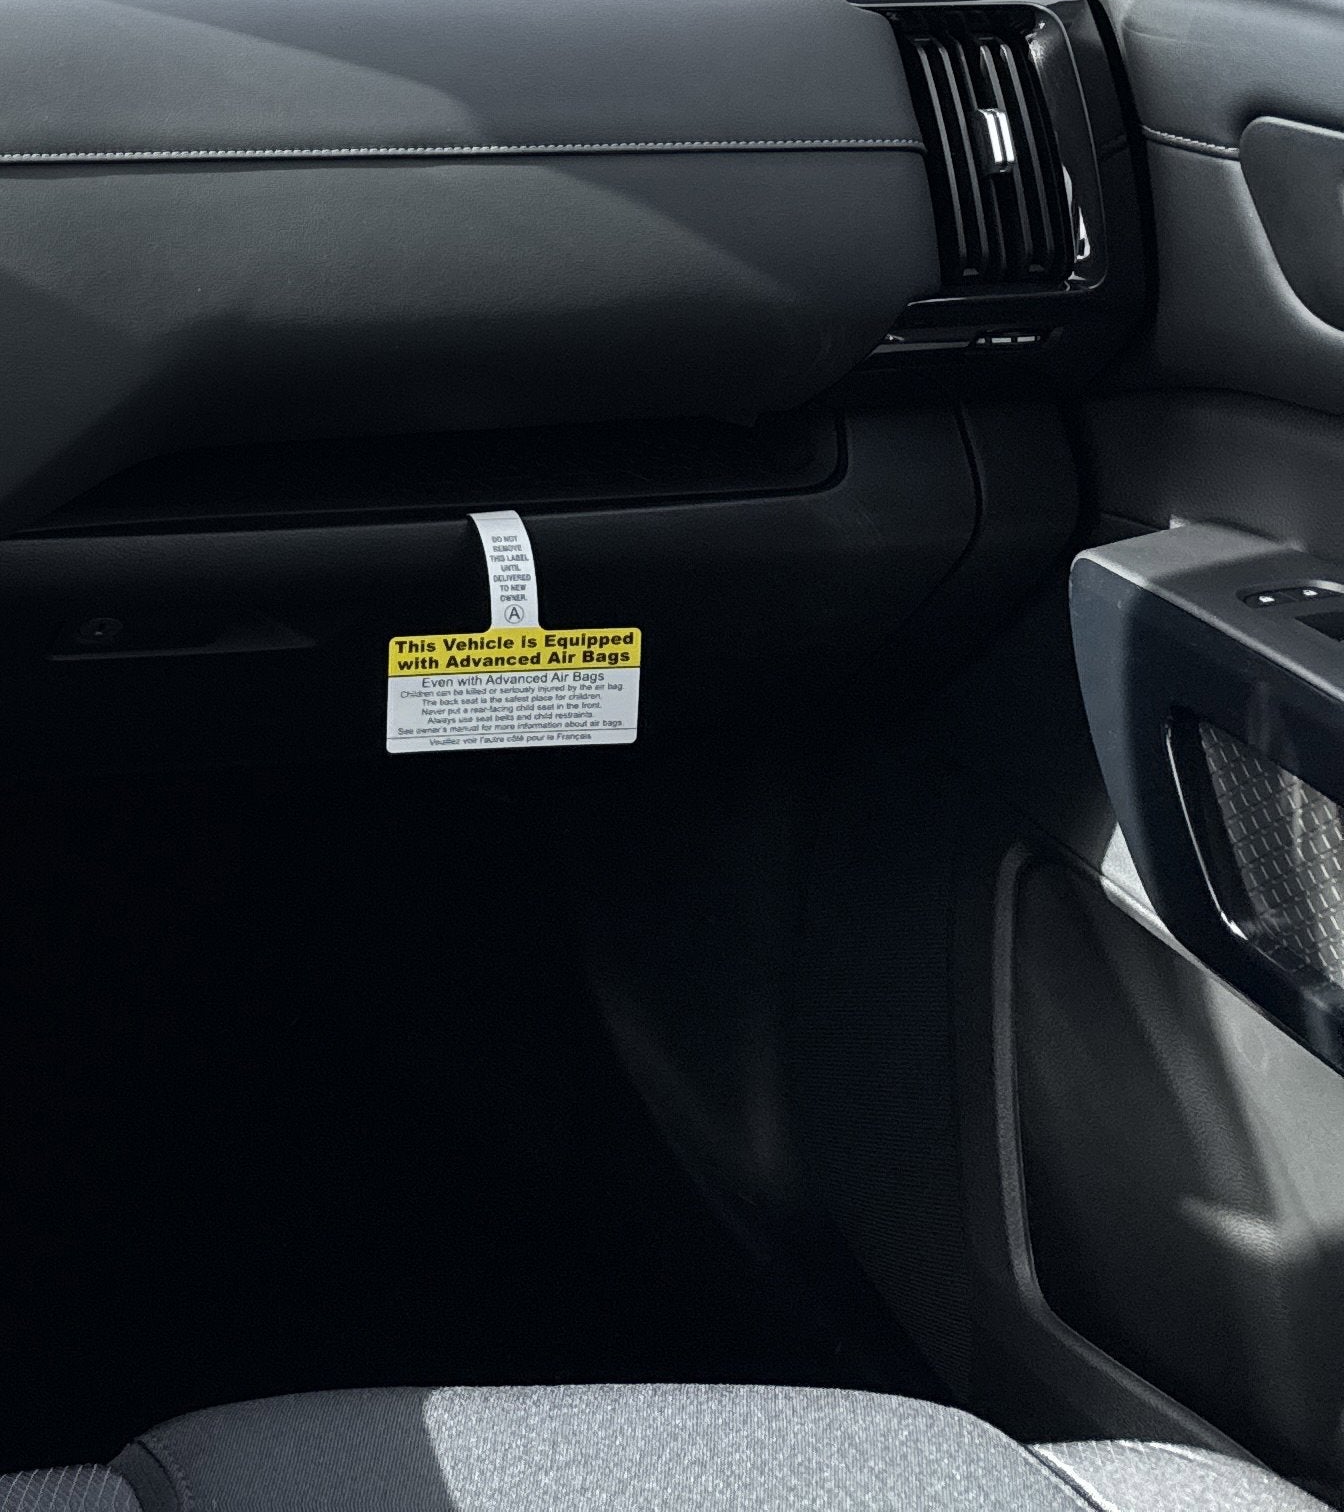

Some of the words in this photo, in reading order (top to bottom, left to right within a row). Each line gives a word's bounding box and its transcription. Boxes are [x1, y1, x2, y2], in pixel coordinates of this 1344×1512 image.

[501, 564, 522, 572] UNTIL
[493, 574, 531, 582] DELIVERED
[395, 640, 436, 654] This
[443, 637, 514, 652] Vehicle
[521, 635, 537, 648] is
[545, 632, 634, 649] Equipped
[398, 656, 439, 670] with
[446, 652, 541, 668] Advanced
[548, 651, 576, 664] Air
[582, 650, 630, 665] Bags
[422, 677, 453, 688] Even
[457, 676, 482, 686] with
[486, 672, 548, 685] Advanced
[551, 672, 569, 682] Air
[572, 671, 605, 684] Bags
